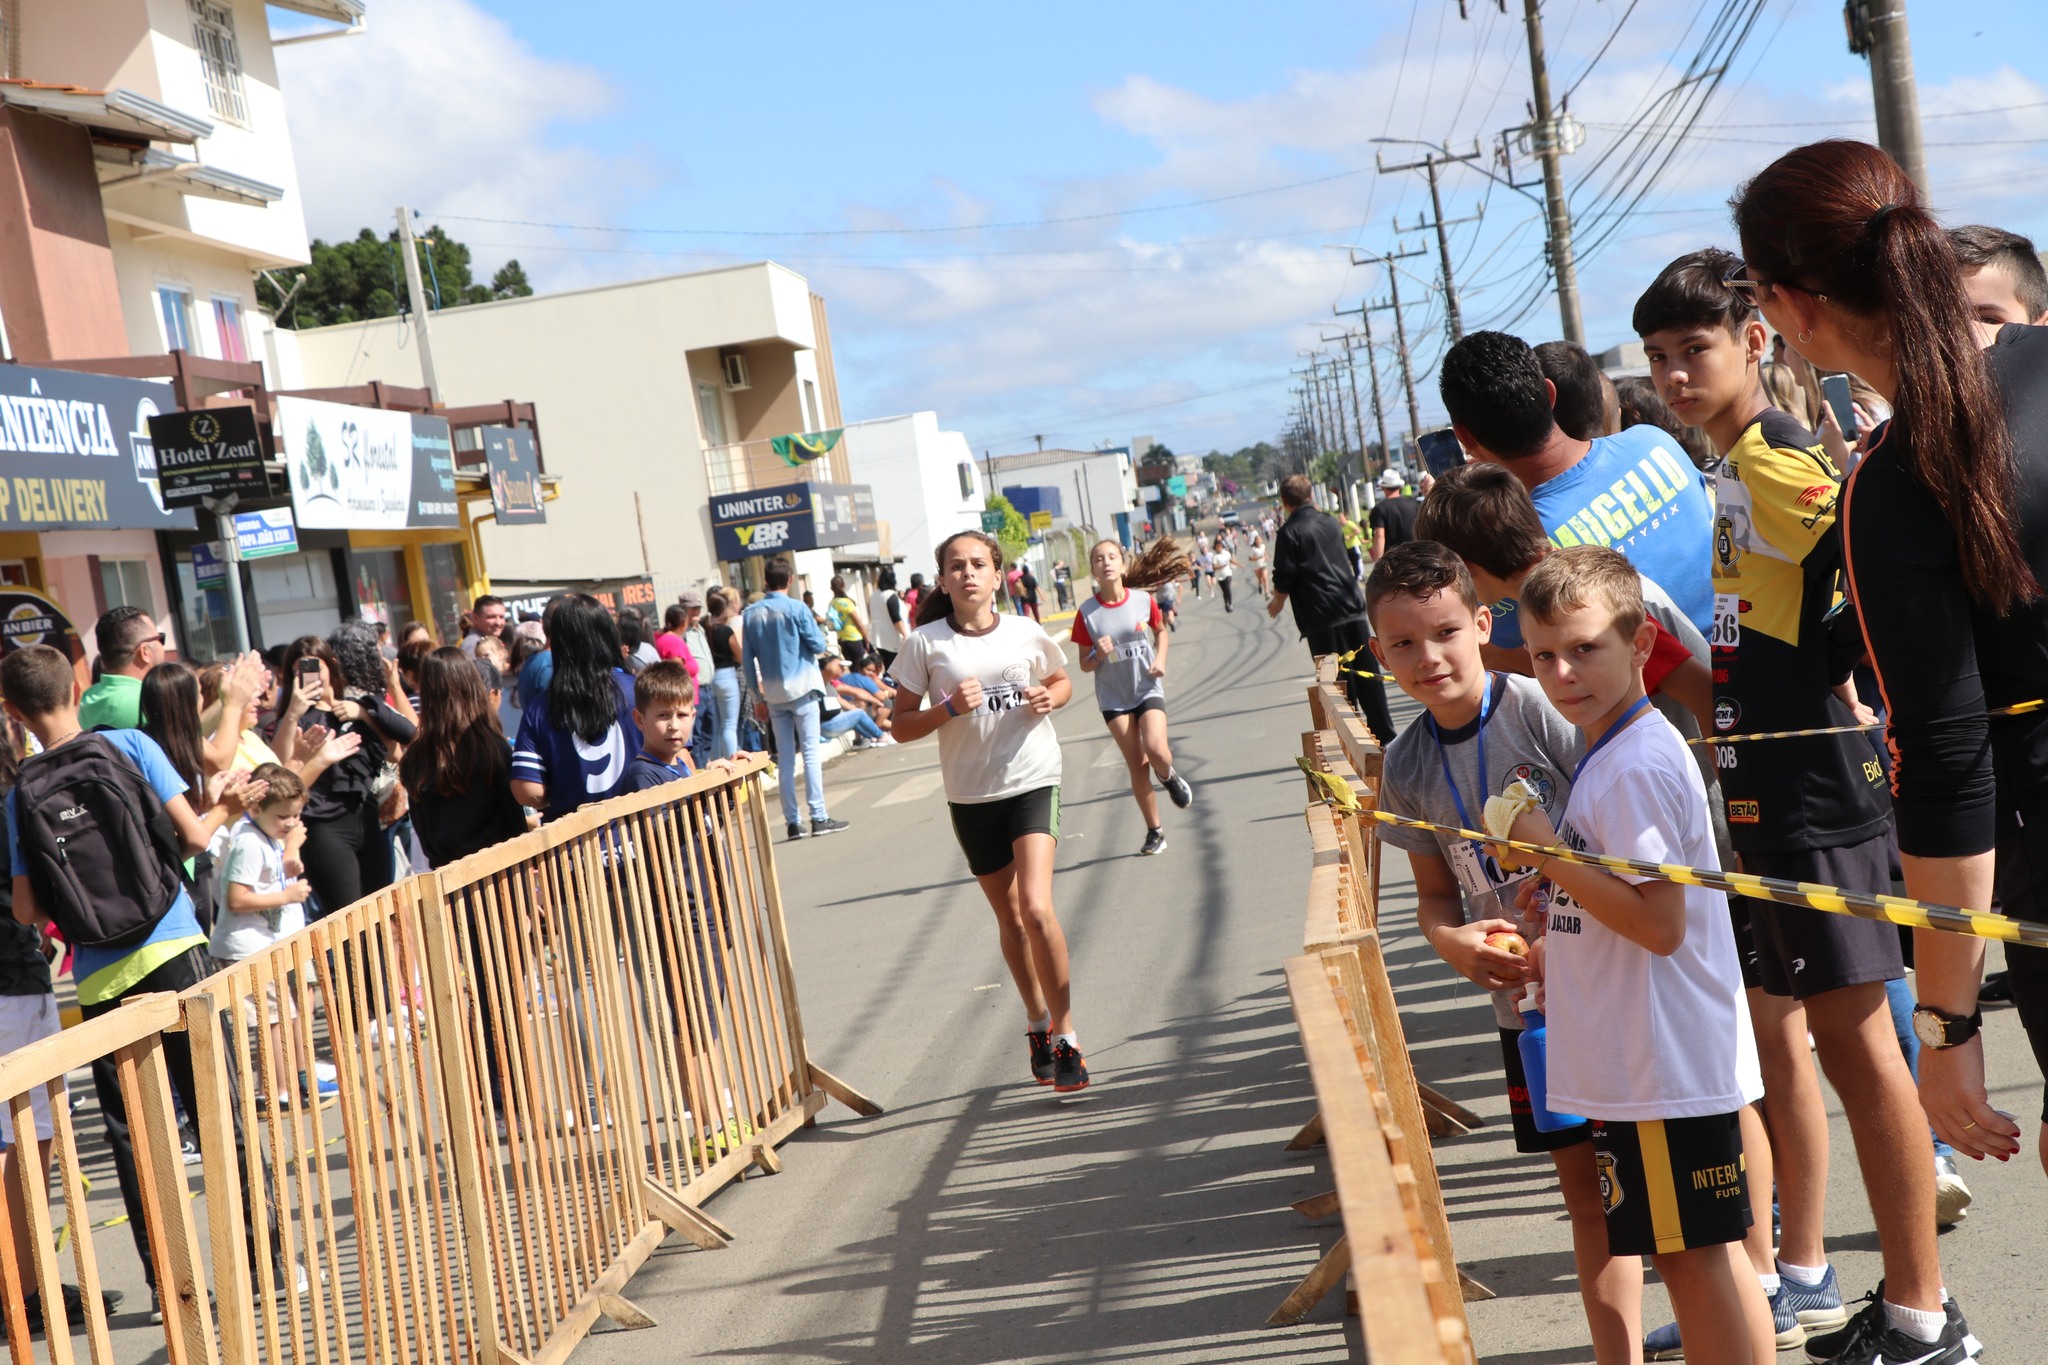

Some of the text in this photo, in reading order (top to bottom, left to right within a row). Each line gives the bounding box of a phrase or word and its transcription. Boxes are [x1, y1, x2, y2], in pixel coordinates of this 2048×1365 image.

[0, 378, 119, 456] NIÊNCIA
[159, 440, 256, 466] Hotel Zenf
[13, 477, 109, 522] DELIVERY
[718, 495, 784, 519] UNINTER
[734, 520, 790, 546] YBR
[3, 618, 53, 635] ANBIER
[988, 690, 1023, 712] 079
[1730, 801, 1758, 816] BETÃO
[1551, 914, 1582, 935] JAZAR
